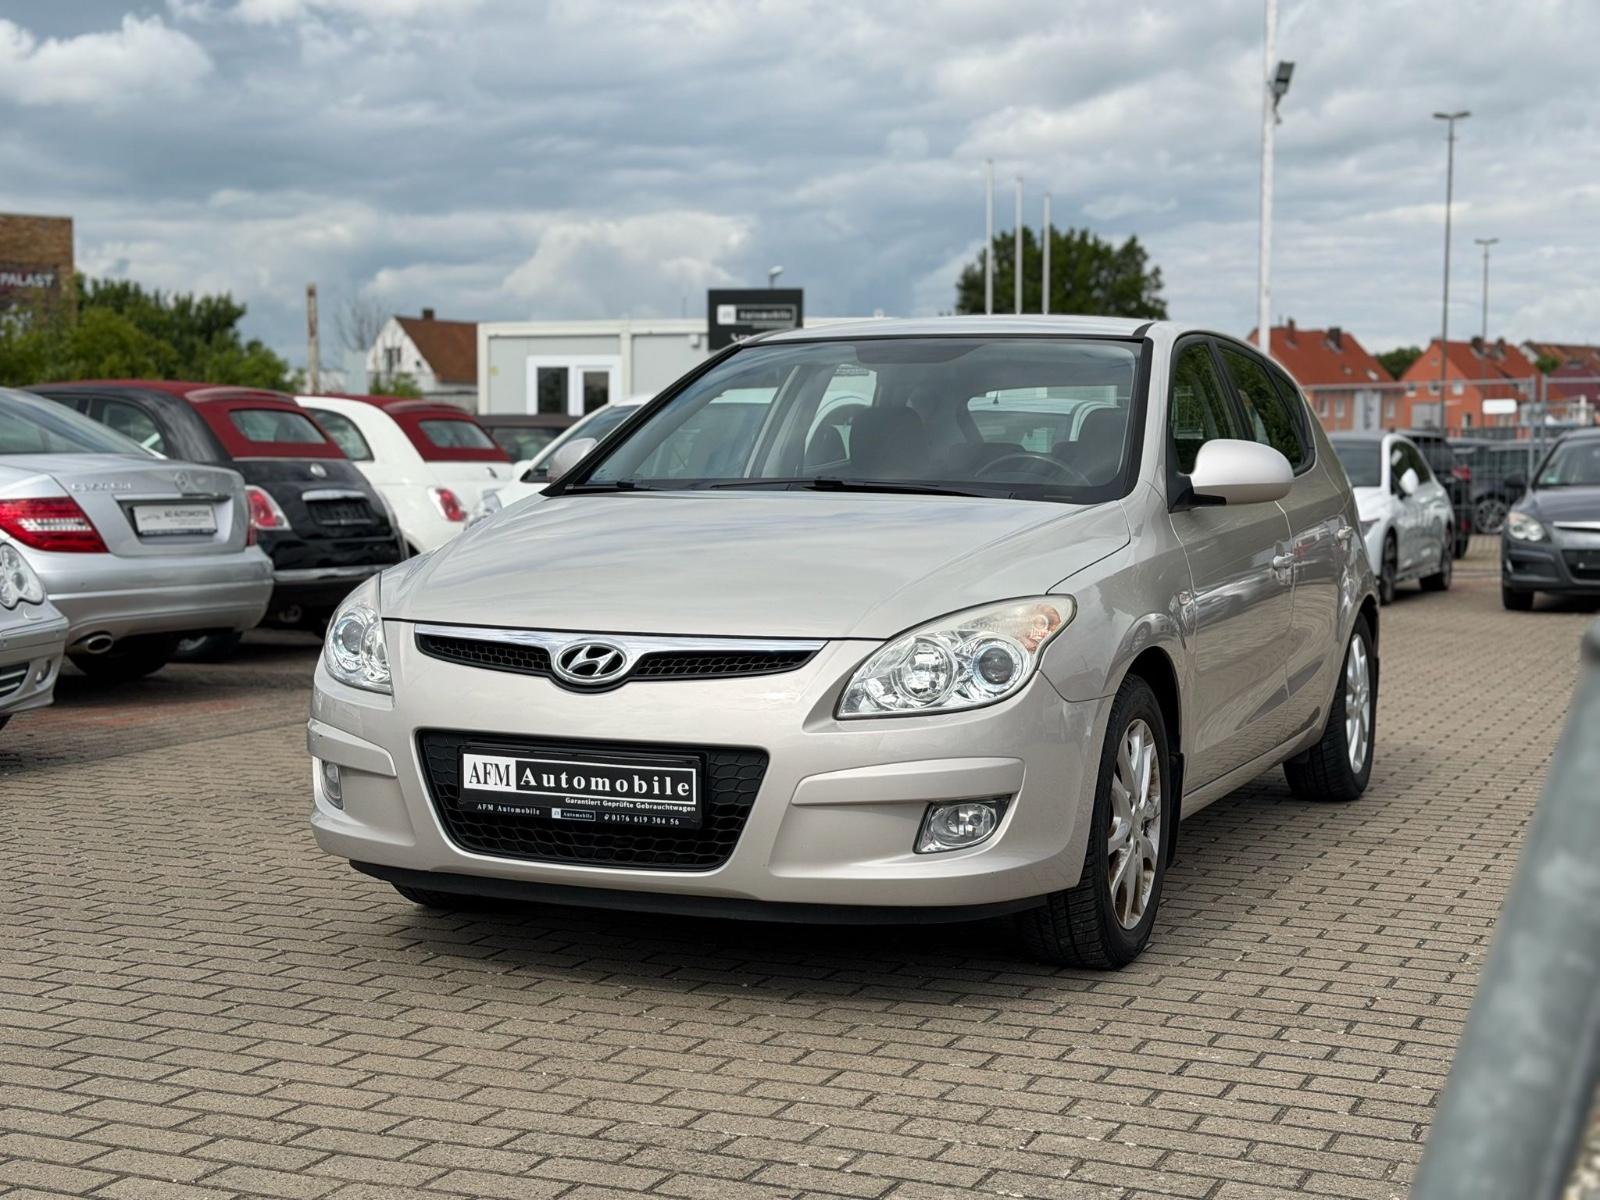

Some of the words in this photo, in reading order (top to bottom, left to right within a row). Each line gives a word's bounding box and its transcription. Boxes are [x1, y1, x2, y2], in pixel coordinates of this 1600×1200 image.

[469, 761, 512, 787] AFM
[520, 767, 690, 796] Automobile
[476, 803, 494, 811] AFM
[497, 805, 540, 815] Automobile
[565, 798, 601, 806] Garantiert
[602, 800, 634, 809] Geprüfte
[636, 803, 696, 813] Gebrauchtwagen
[611, 814, 630, 822] 0176
